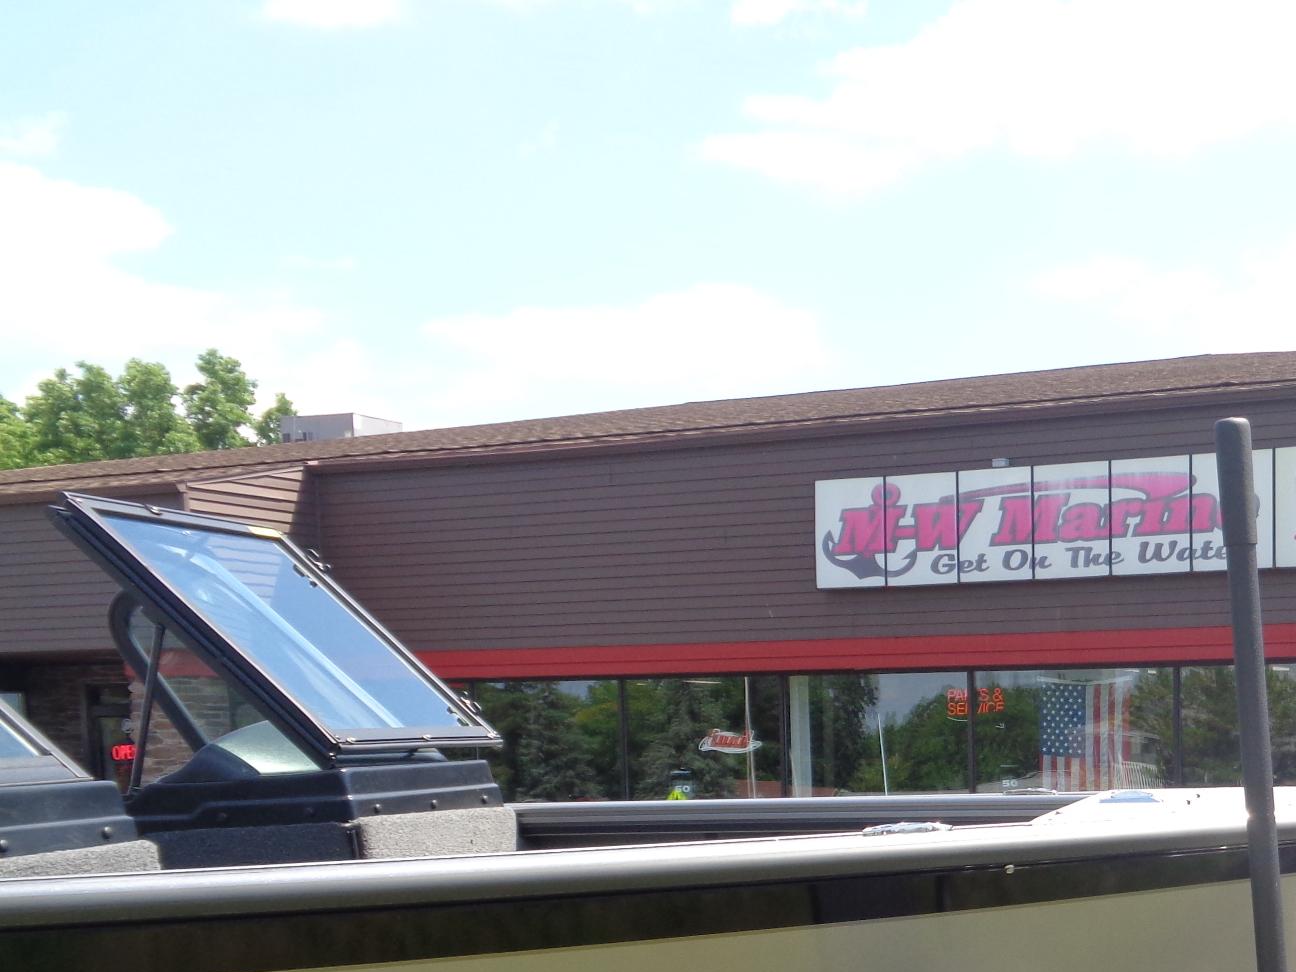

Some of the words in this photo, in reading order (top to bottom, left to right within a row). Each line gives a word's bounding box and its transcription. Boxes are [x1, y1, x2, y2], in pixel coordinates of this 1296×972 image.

[989, 492, 1260, 546] Marin
[930, 552, 990, 575] Get
[1002, 548, 1053, 571] On
[1065, 546, 1125, 569] The
[1138, 540, 1228, 564] Wate
[947, 687, 989, 702] PAS
[947, 702, 1005, 715] SEICE
[112, 744, 137, 760] OPE
